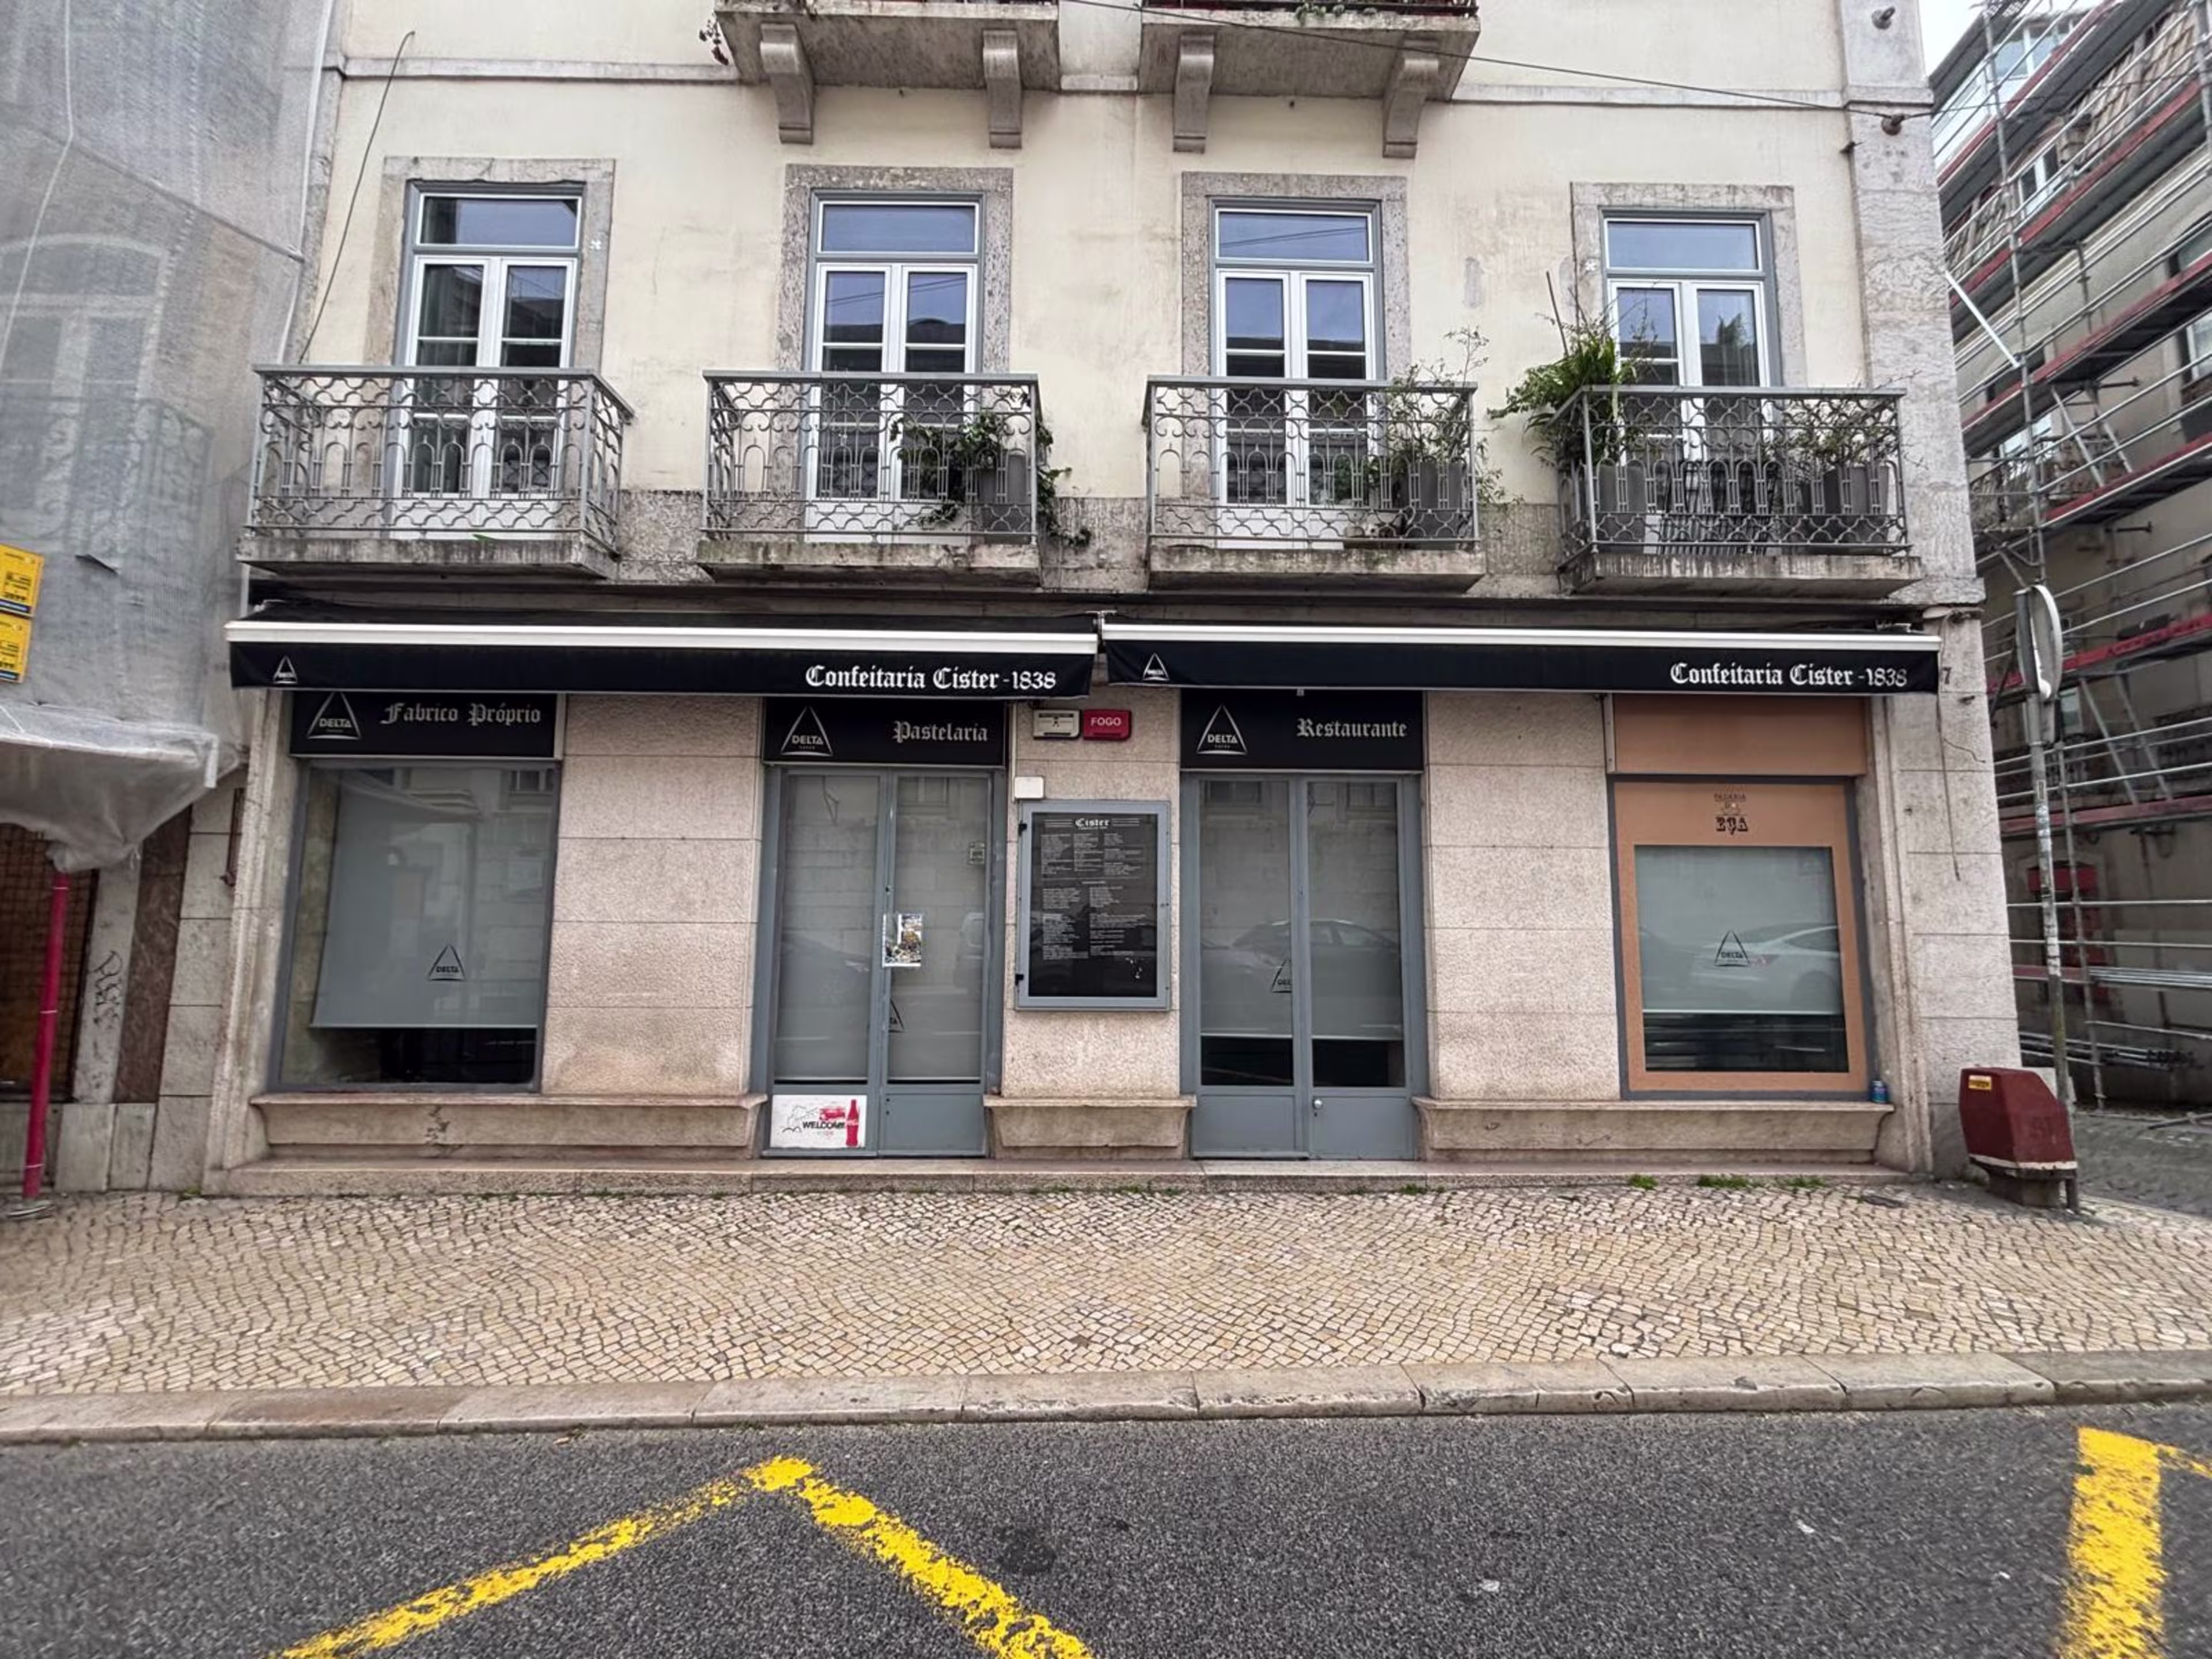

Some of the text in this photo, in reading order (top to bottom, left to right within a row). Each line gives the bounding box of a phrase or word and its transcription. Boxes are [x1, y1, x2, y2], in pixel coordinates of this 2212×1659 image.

[806, 665, 925, 687] Confeitaria
[933, 666, 999, 689] Cister
[1671, 662, 1783, 684] Confeitaria
[1790, 664, 1853, 685] Cister
[380, 702, 541, 726] Fabrico Próprio
[319, 719, 351, 728] DELTA
[1090, 717, 1122, 726] FOGO
[892, 721, 988, 743] Pastelaria
[1297, 718, 1407, 737] Restaurante
[792, 735, 824, 745] DELTA
[1207, 734, 1238, 743] DELTA
[1075, 818, 1109, 827] Cister
[802, 1121, 844, 1129] WELCOME
